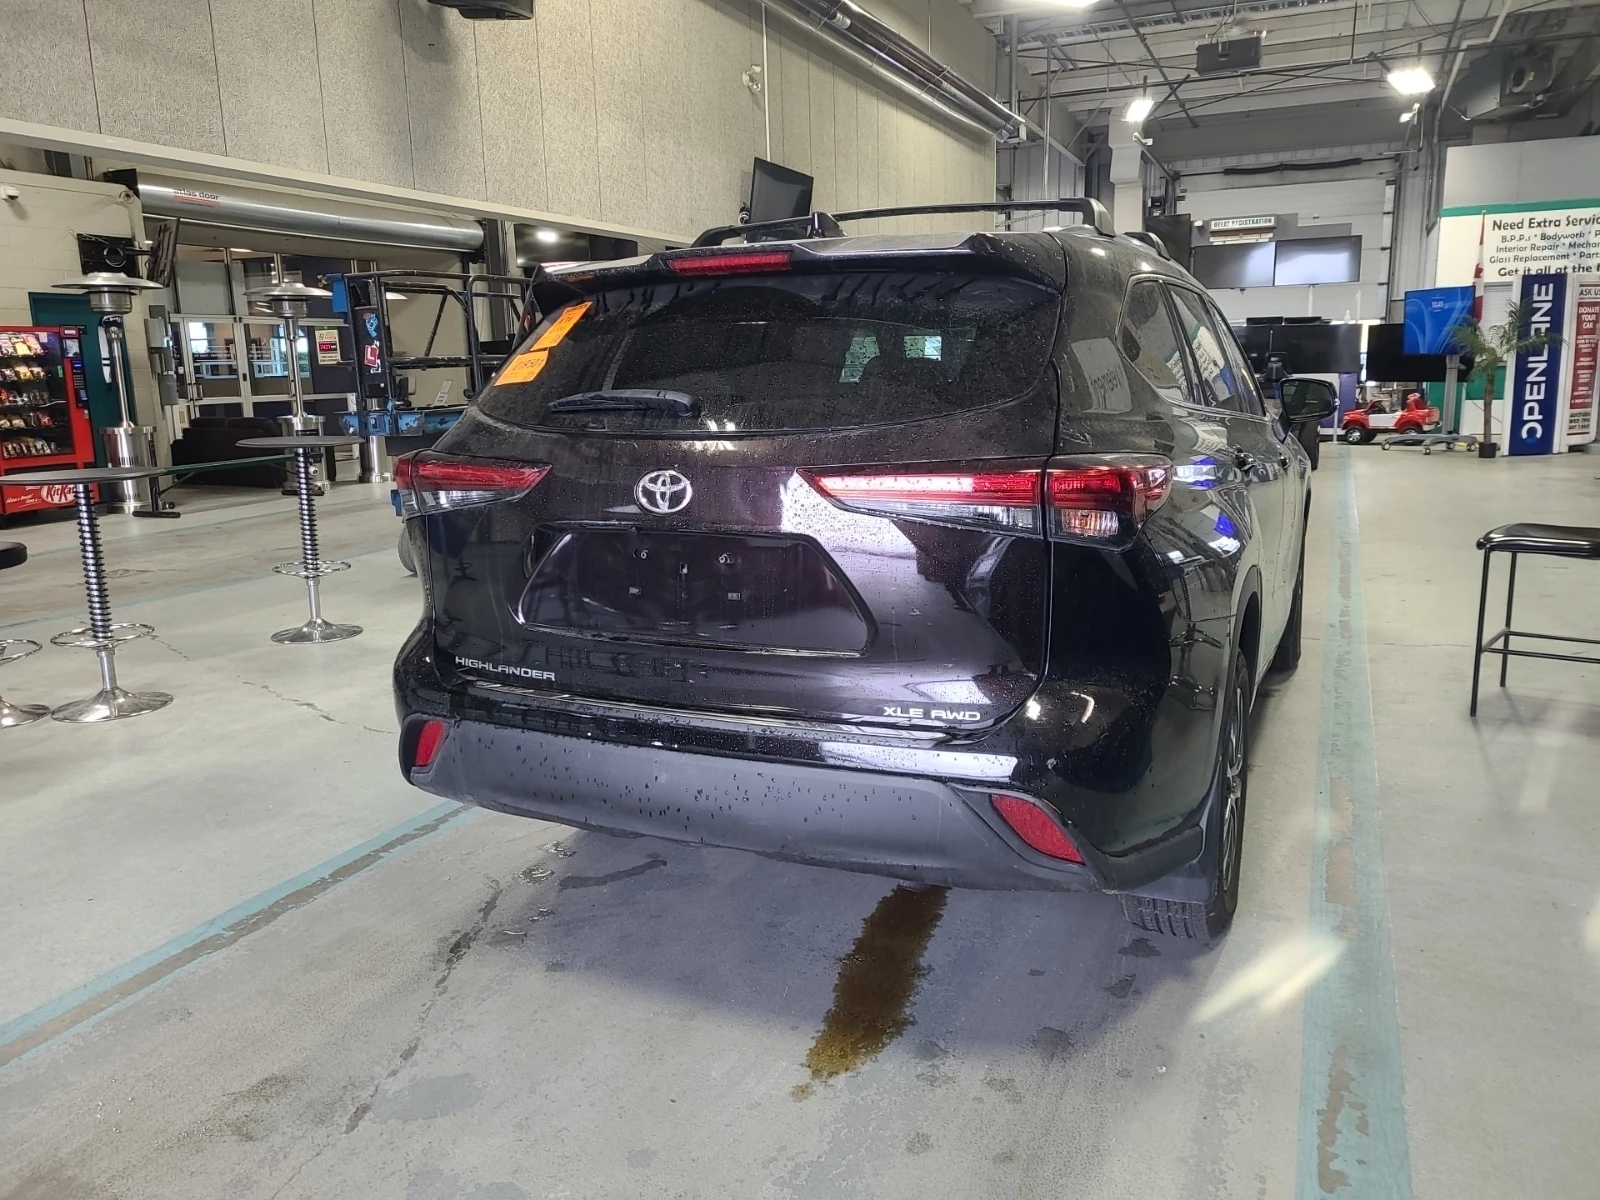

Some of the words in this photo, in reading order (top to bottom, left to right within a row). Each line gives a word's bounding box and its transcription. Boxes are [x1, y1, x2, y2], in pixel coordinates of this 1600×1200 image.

[173, 188, 197, 197] atlas
[199, 192, 219, 200] door
[1492, 218, 1524, 231] Need
[1528, 217, 1561, 229] Extra
[1540, 231, 1585, 241] Bodywork
[1496, 245, 1527, 253] Interior
[1530, 242, 1559, 252] Repair
[1489, 255, 1511, 264] Glass
[1513, 252, 1570, 263] Replacement
[1498, 267, 1519, 277] Get
[1523, 266, 1532, 275] it
[1536, 266, 1551, 274] all
[1555, 265, 1568, 273] at
[1572, 263, 1593, 273] the
[1579, 288, 1592, 296] ASK
[1578, 306, 1600, 314] DONATE
[1521, 283, 1554, 442] OPENLANE
[46, 484, 76, 502] KitKat
[455, 656, 556, 681] HIGHLANDER
[883, 706, 924, 718] XLE
[930, 709, 981, 721] AWD
